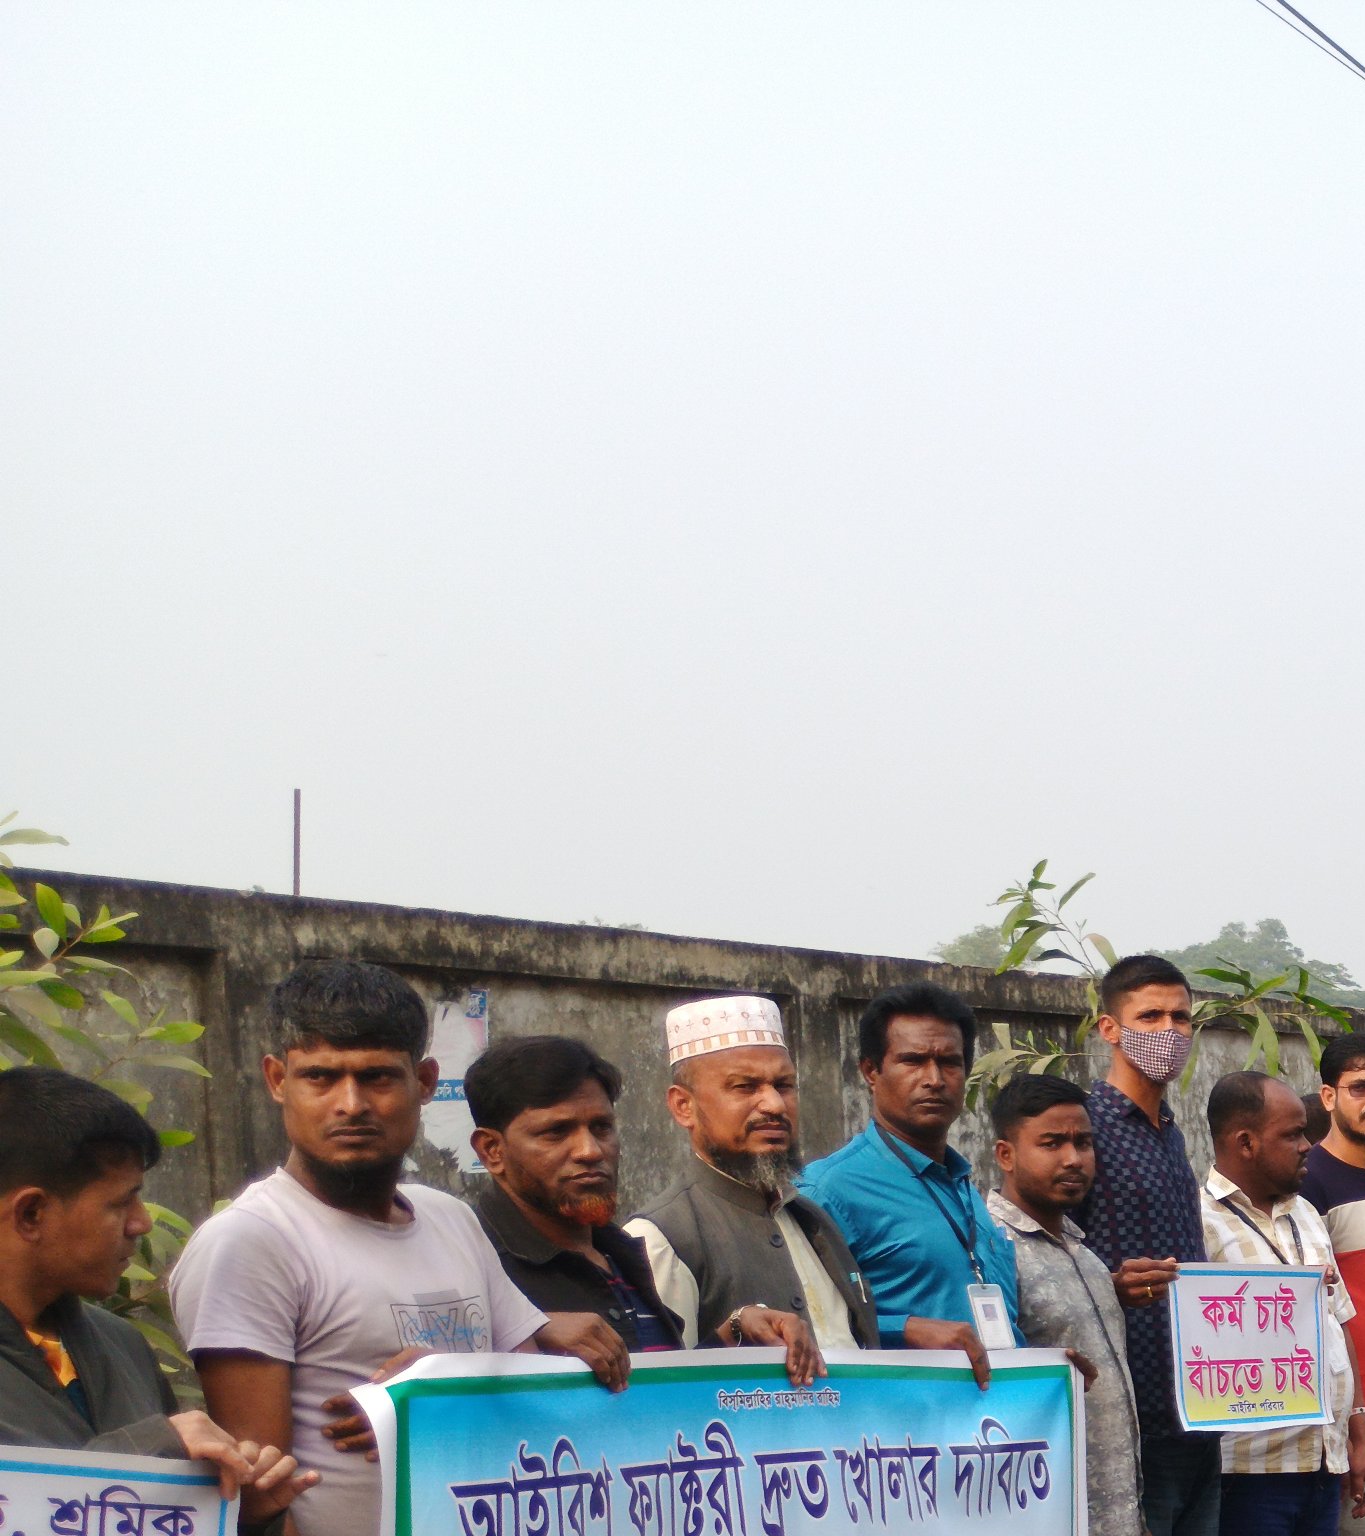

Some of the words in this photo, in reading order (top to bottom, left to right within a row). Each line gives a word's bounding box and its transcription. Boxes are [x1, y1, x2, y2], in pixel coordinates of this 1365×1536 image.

[1199, 1280, 1249, 1334] কর্ম
[1254, 1283, 1297, 1335] চাই
[1185, 1345, 1264, 1397] বাঁচতে
[1271, 1344, 1315, 1396] চাই
[834, 1434, 941, 1525] খোলার
[949, 1417, 1051, 1518] দাবিতে
